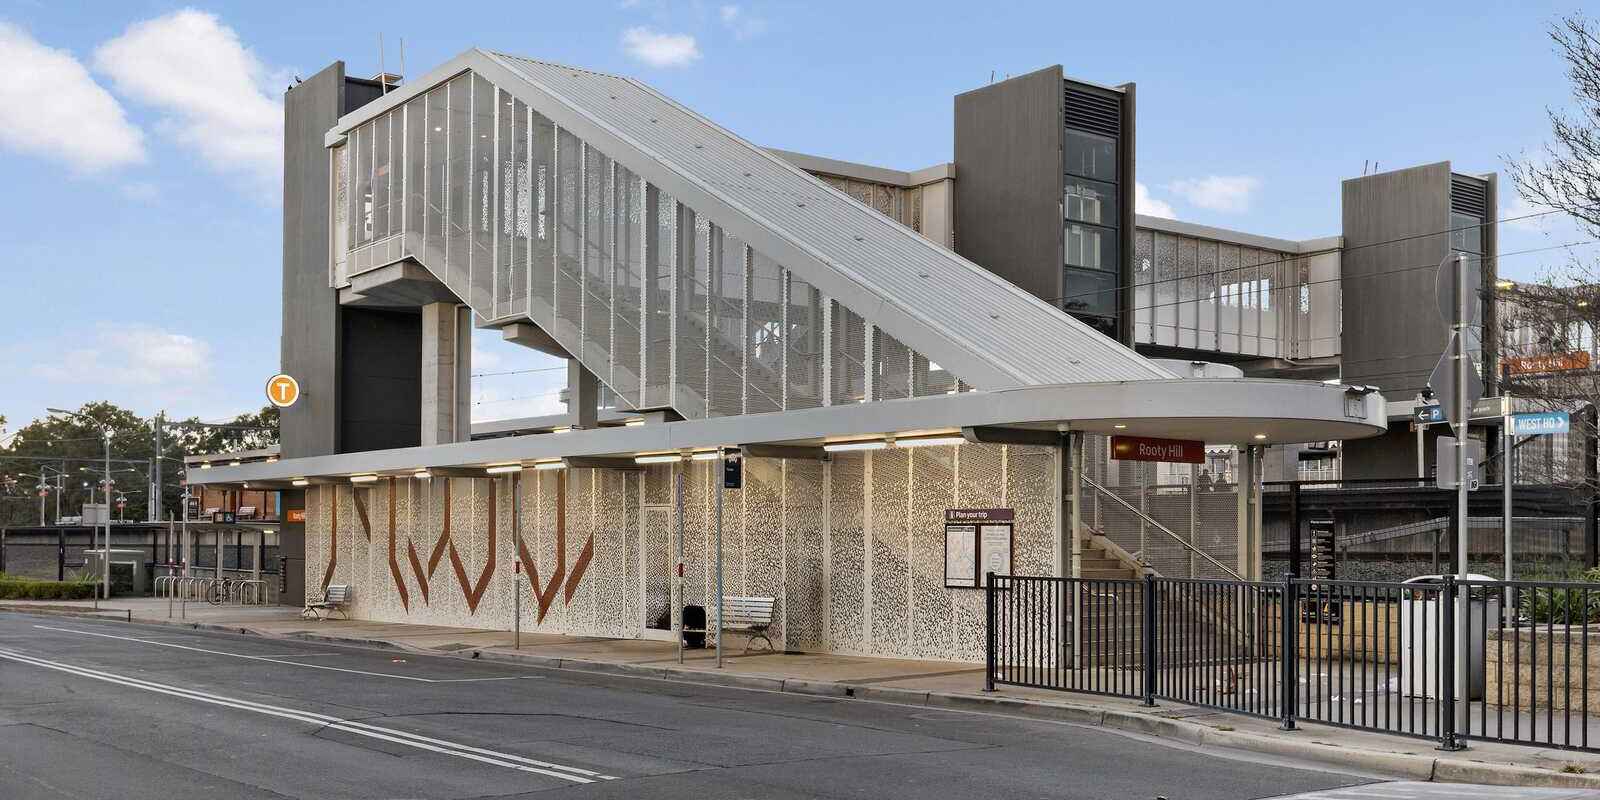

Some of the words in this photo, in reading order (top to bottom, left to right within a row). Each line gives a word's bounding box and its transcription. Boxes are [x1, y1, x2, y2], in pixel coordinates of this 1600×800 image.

[276, 382, 290, 401] T
[1432, 408, 1441, 419] P
[1518, 417, 1541, 431] WEST
[1139, 443, 1167, 459] Rooty
[1169, 444, 1183, 457] Hill
[967, 512, 978, 520] your
[978, 511, 988, 520] trip
